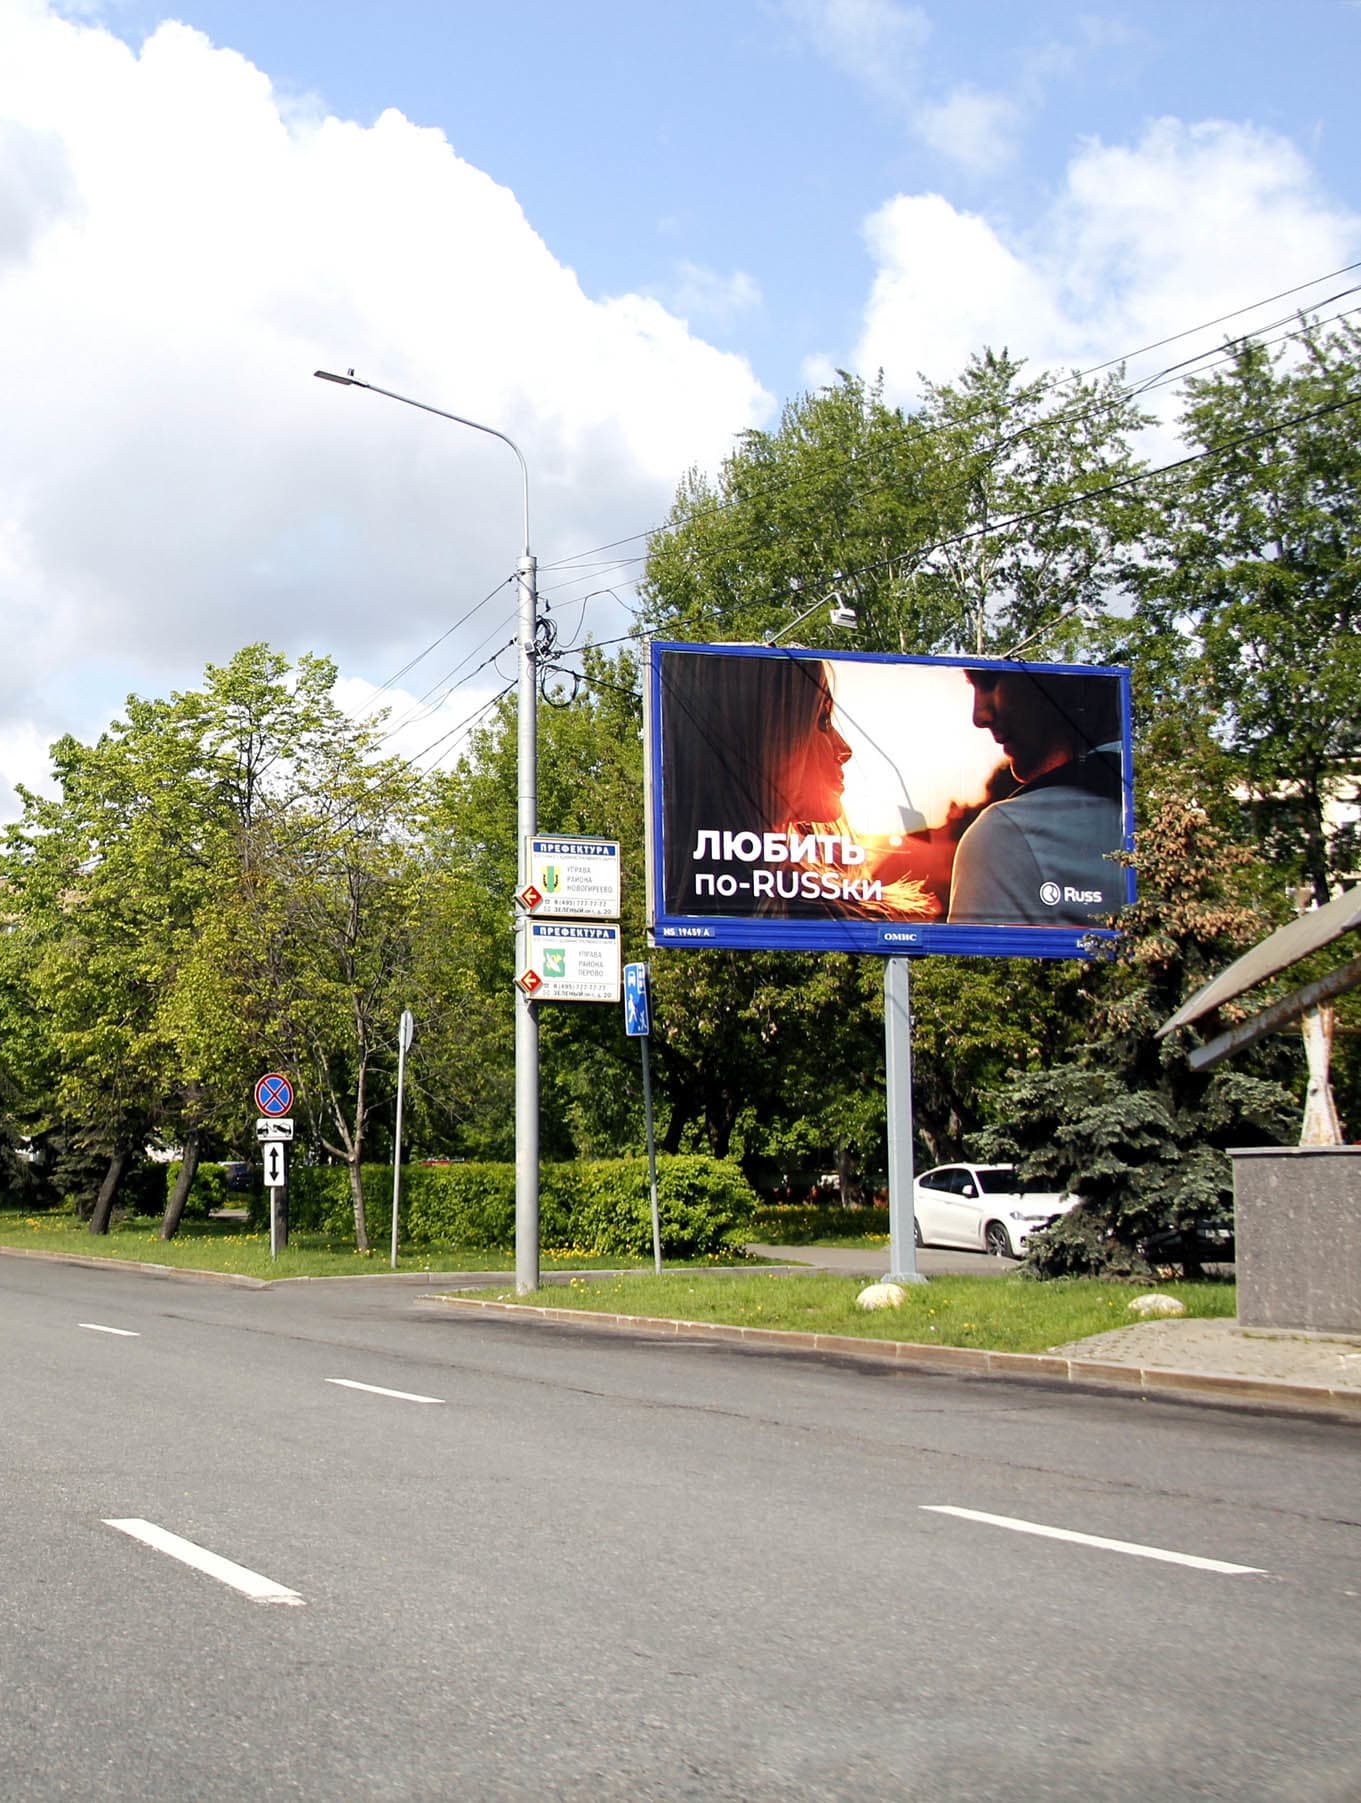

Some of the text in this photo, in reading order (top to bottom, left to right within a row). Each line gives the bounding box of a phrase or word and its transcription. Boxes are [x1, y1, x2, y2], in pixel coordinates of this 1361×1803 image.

[540, 843, 610, 855] ПРЕФЕКТУРА
[692, 830, 865, 865] ЛЮБИТЬ
[567, 885, 613, 894] НОВОГИРЕЕВО
[695, 869, 883, 901] по-RUSSки
[1064, 886, 1102, 903] Russ
[540, 926, 610, 938] ПРЕФЕКТУРА
[884, 932, 918, 942] ОМИС
